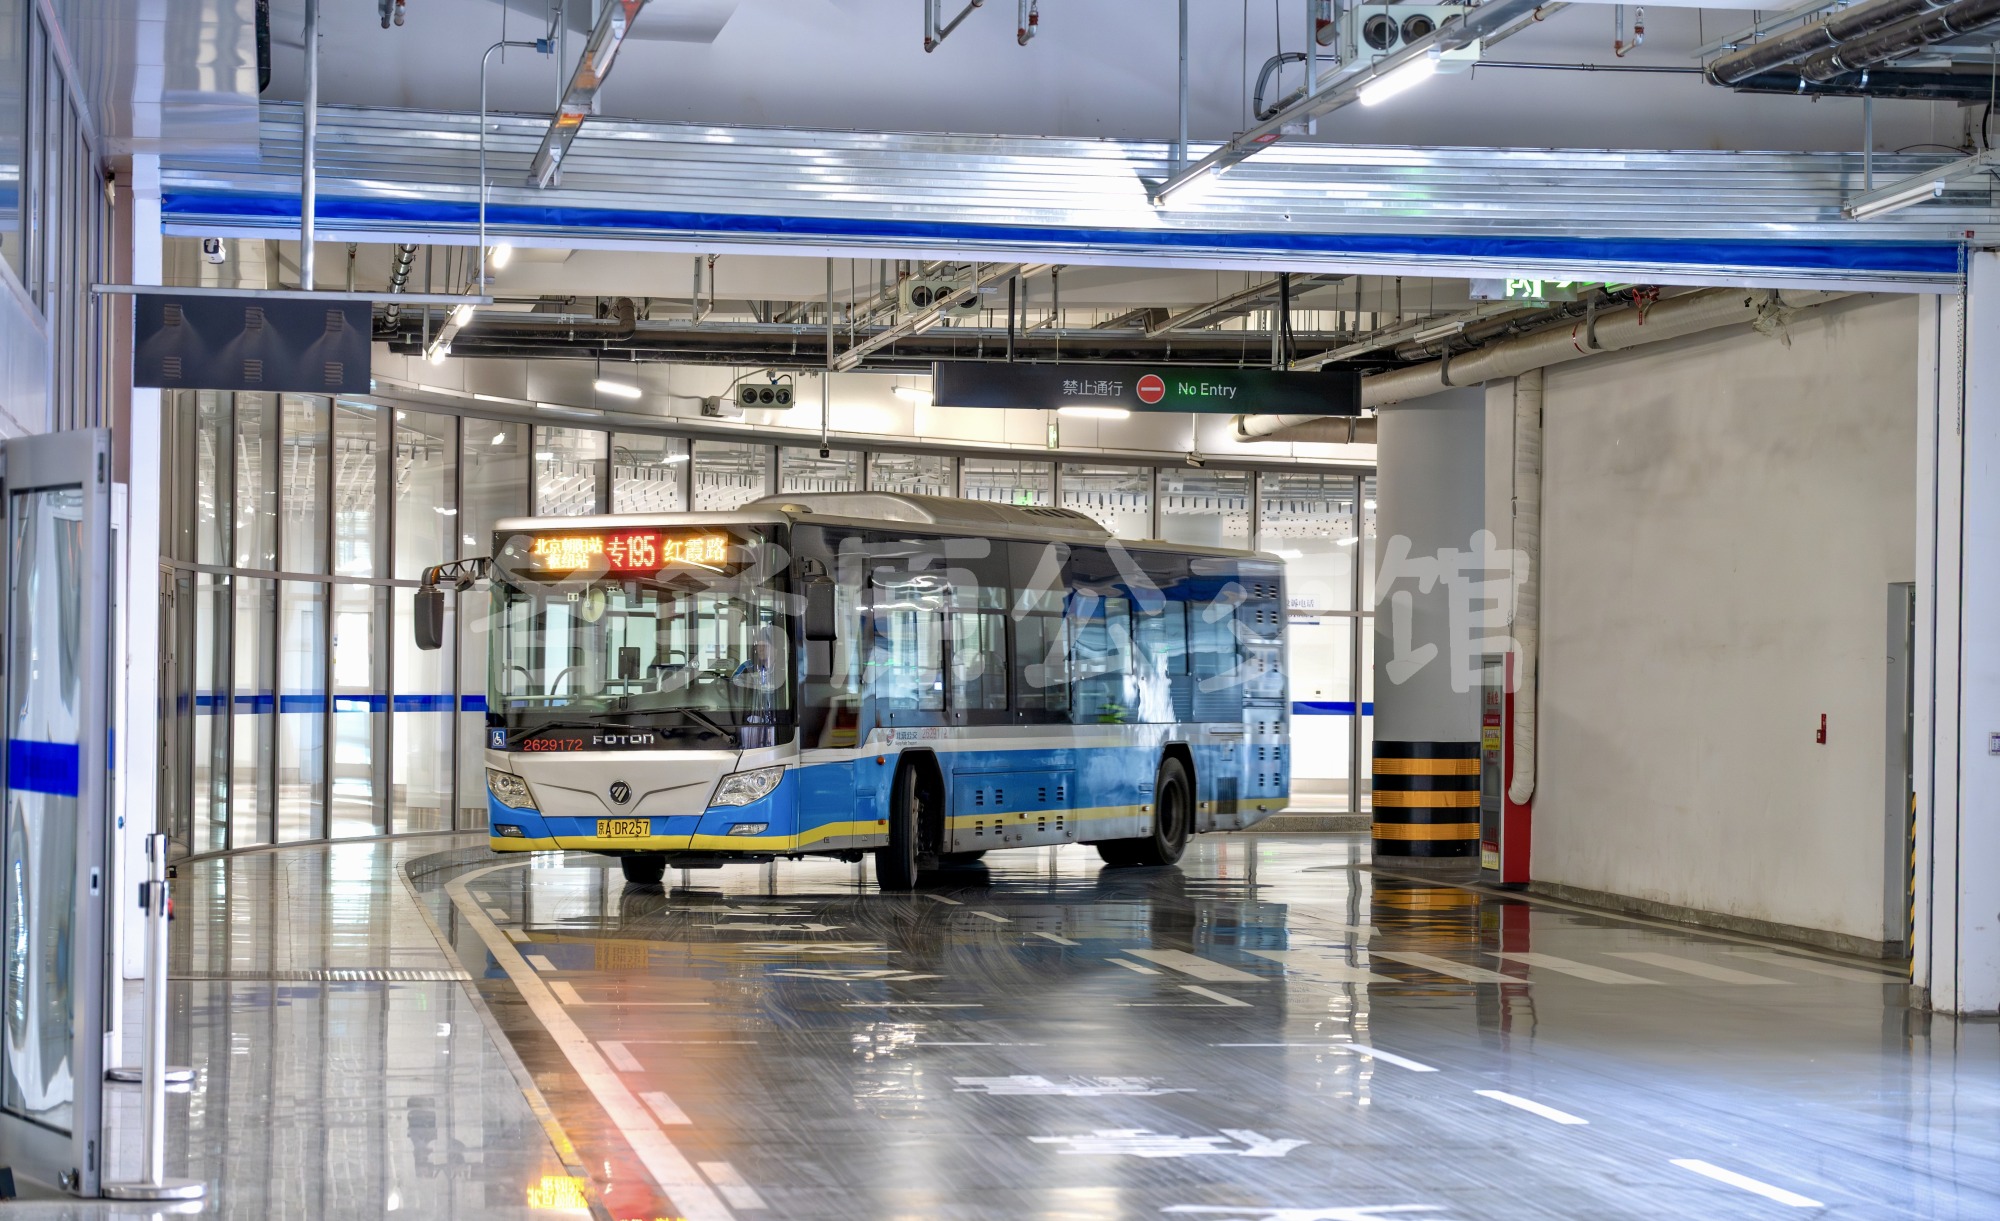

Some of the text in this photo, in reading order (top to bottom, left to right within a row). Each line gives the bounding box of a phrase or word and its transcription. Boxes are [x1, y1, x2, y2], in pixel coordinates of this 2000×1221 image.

[1062, 379, 1124, 397] 禁止通行
[1178, 382, 1237, 399] No Entry
[606, 535, 655, 568] 专195
[663, 538, 727, 562] 红霞路
[523, 739, 583, 751] 2629172
[593, 734, 655, 745] FOTON
